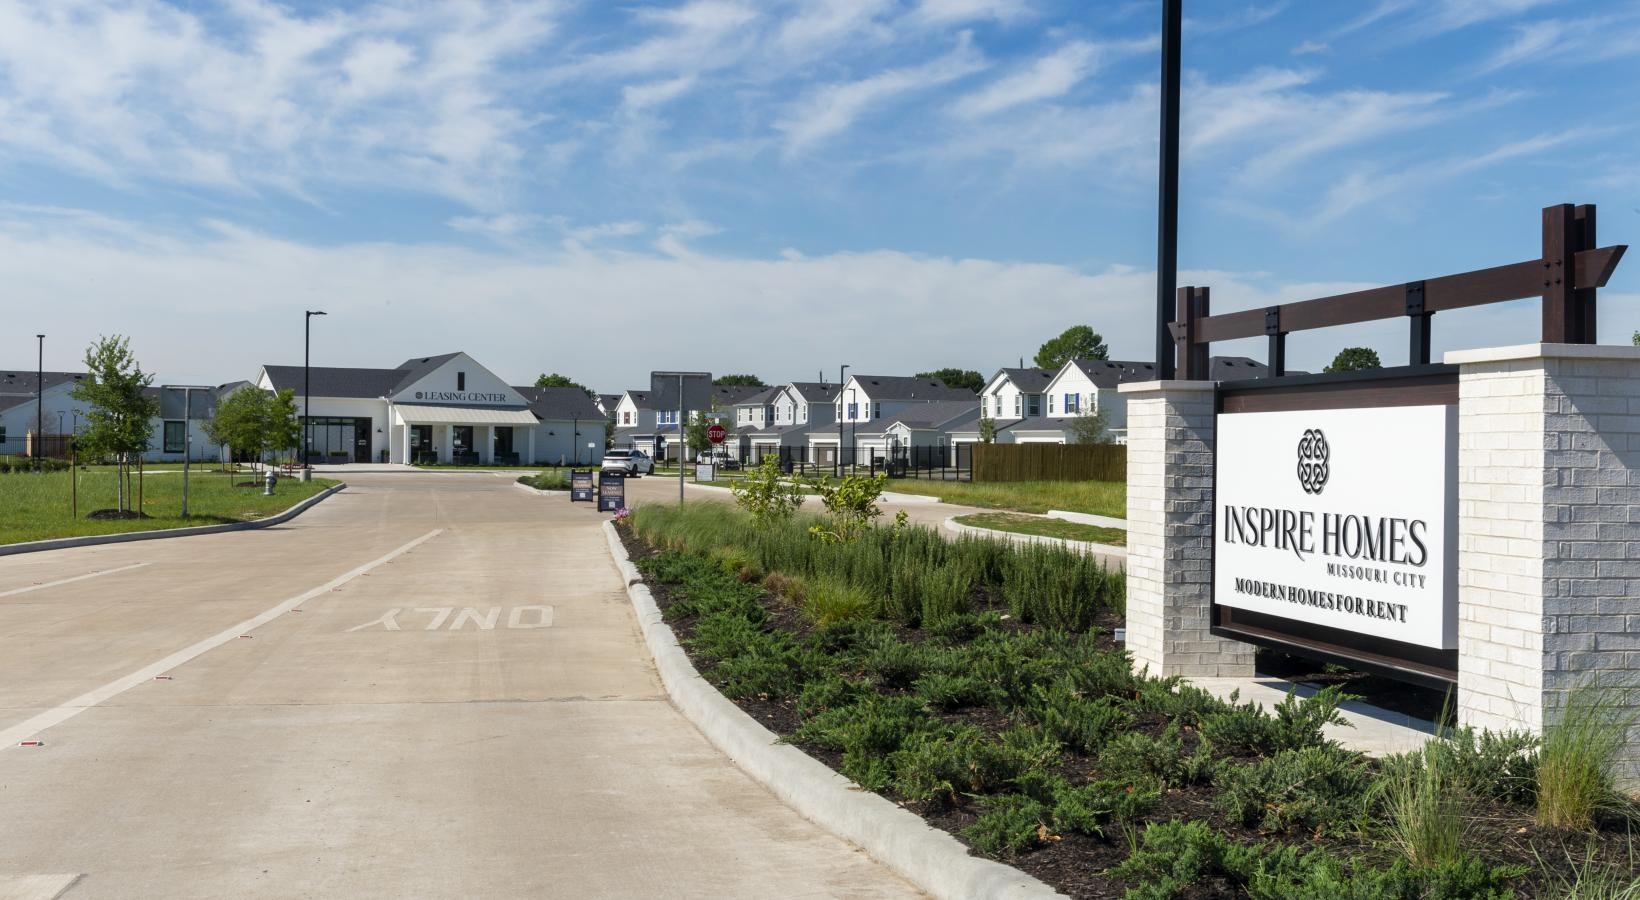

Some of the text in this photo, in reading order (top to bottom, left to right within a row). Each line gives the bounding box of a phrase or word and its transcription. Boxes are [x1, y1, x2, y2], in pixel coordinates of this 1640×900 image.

[424, 391, 506, 402] LEASING CENTER
[708, 430, 725, 438] STOP
[1224, 504, 1428, 567] INSPIRE HOMES
[1327, 562, 1426, 589] MISSOURI CITY
[1234, 577, 1409, 623] MODERN HOMES FOR RENT
[343, 604, 554, 633] ONLY
